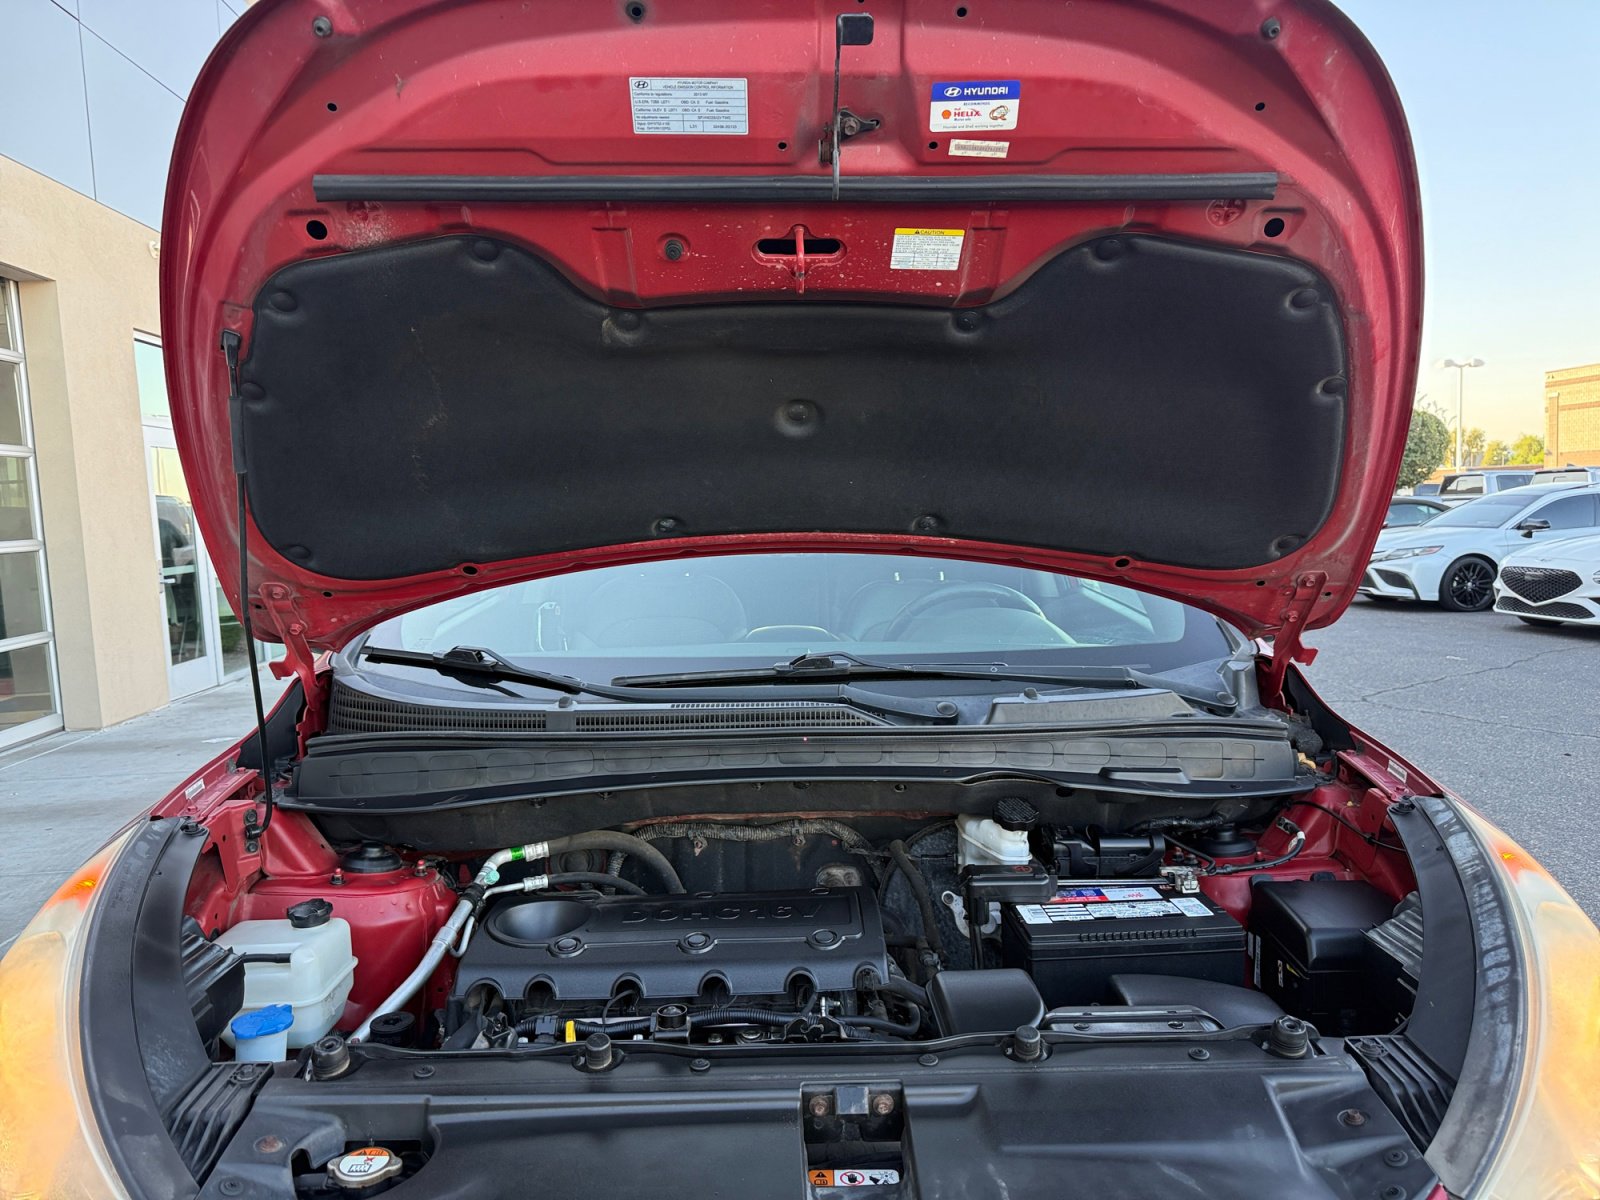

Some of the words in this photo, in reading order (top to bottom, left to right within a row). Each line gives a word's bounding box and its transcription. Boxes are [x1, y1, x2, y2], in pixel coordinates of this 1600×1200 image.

[964, 86, 1009, 96] HYUNDAI
[954, 109, 980, 117] HELIX
[622, 907, 741, 923] DOHC
